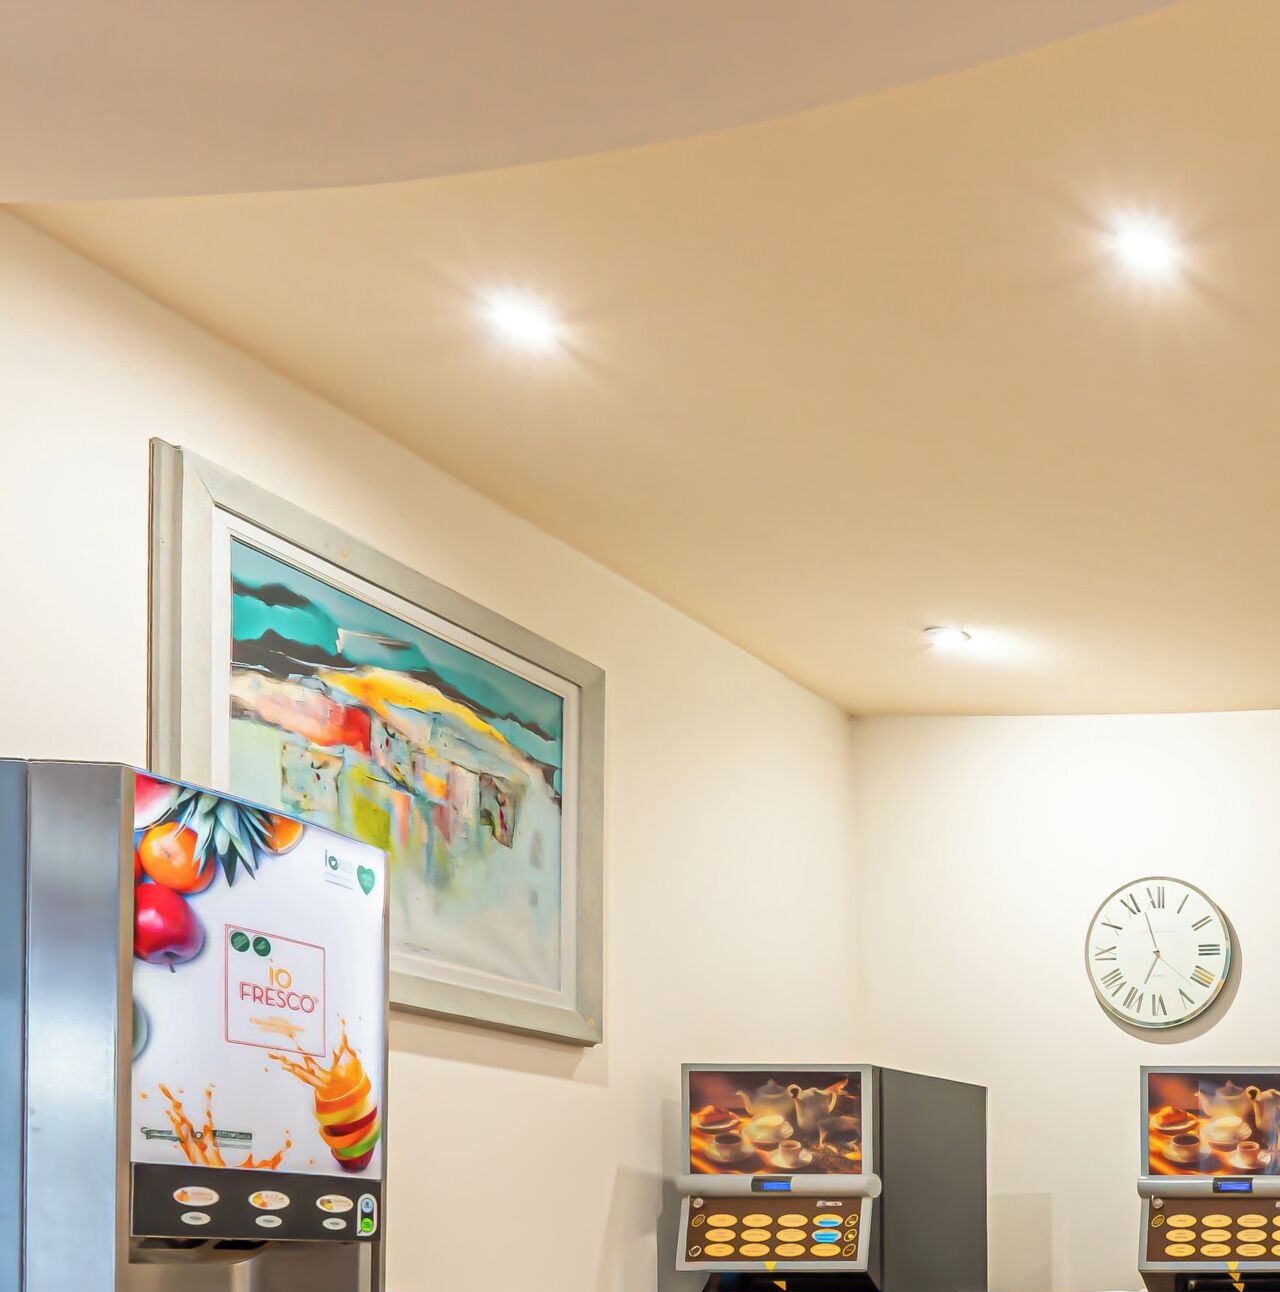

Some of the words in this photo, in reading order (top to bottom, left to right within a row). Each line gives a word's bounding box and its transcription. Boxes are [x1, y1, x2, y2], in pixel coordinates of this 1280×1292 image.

[1119, 893, 1142, 920] XI
[1145, 886, 1165, 909] XII
[1176, 893, 1190, 914] I
[1101, 914, 1123, 936] X
[1191, 914, 1213, 931] II
[1094, 945, 1118, 961] IX
[1198, 943, 1221, 956] III
[1101, 968, 1127, 998] VIII
[1190, 965, 1216, 988] IIII
[1122, 986, 1144, 1013] VII
[1151, 992, 1168, 1017] VI
[1178, 988, 1196, 1009] V
